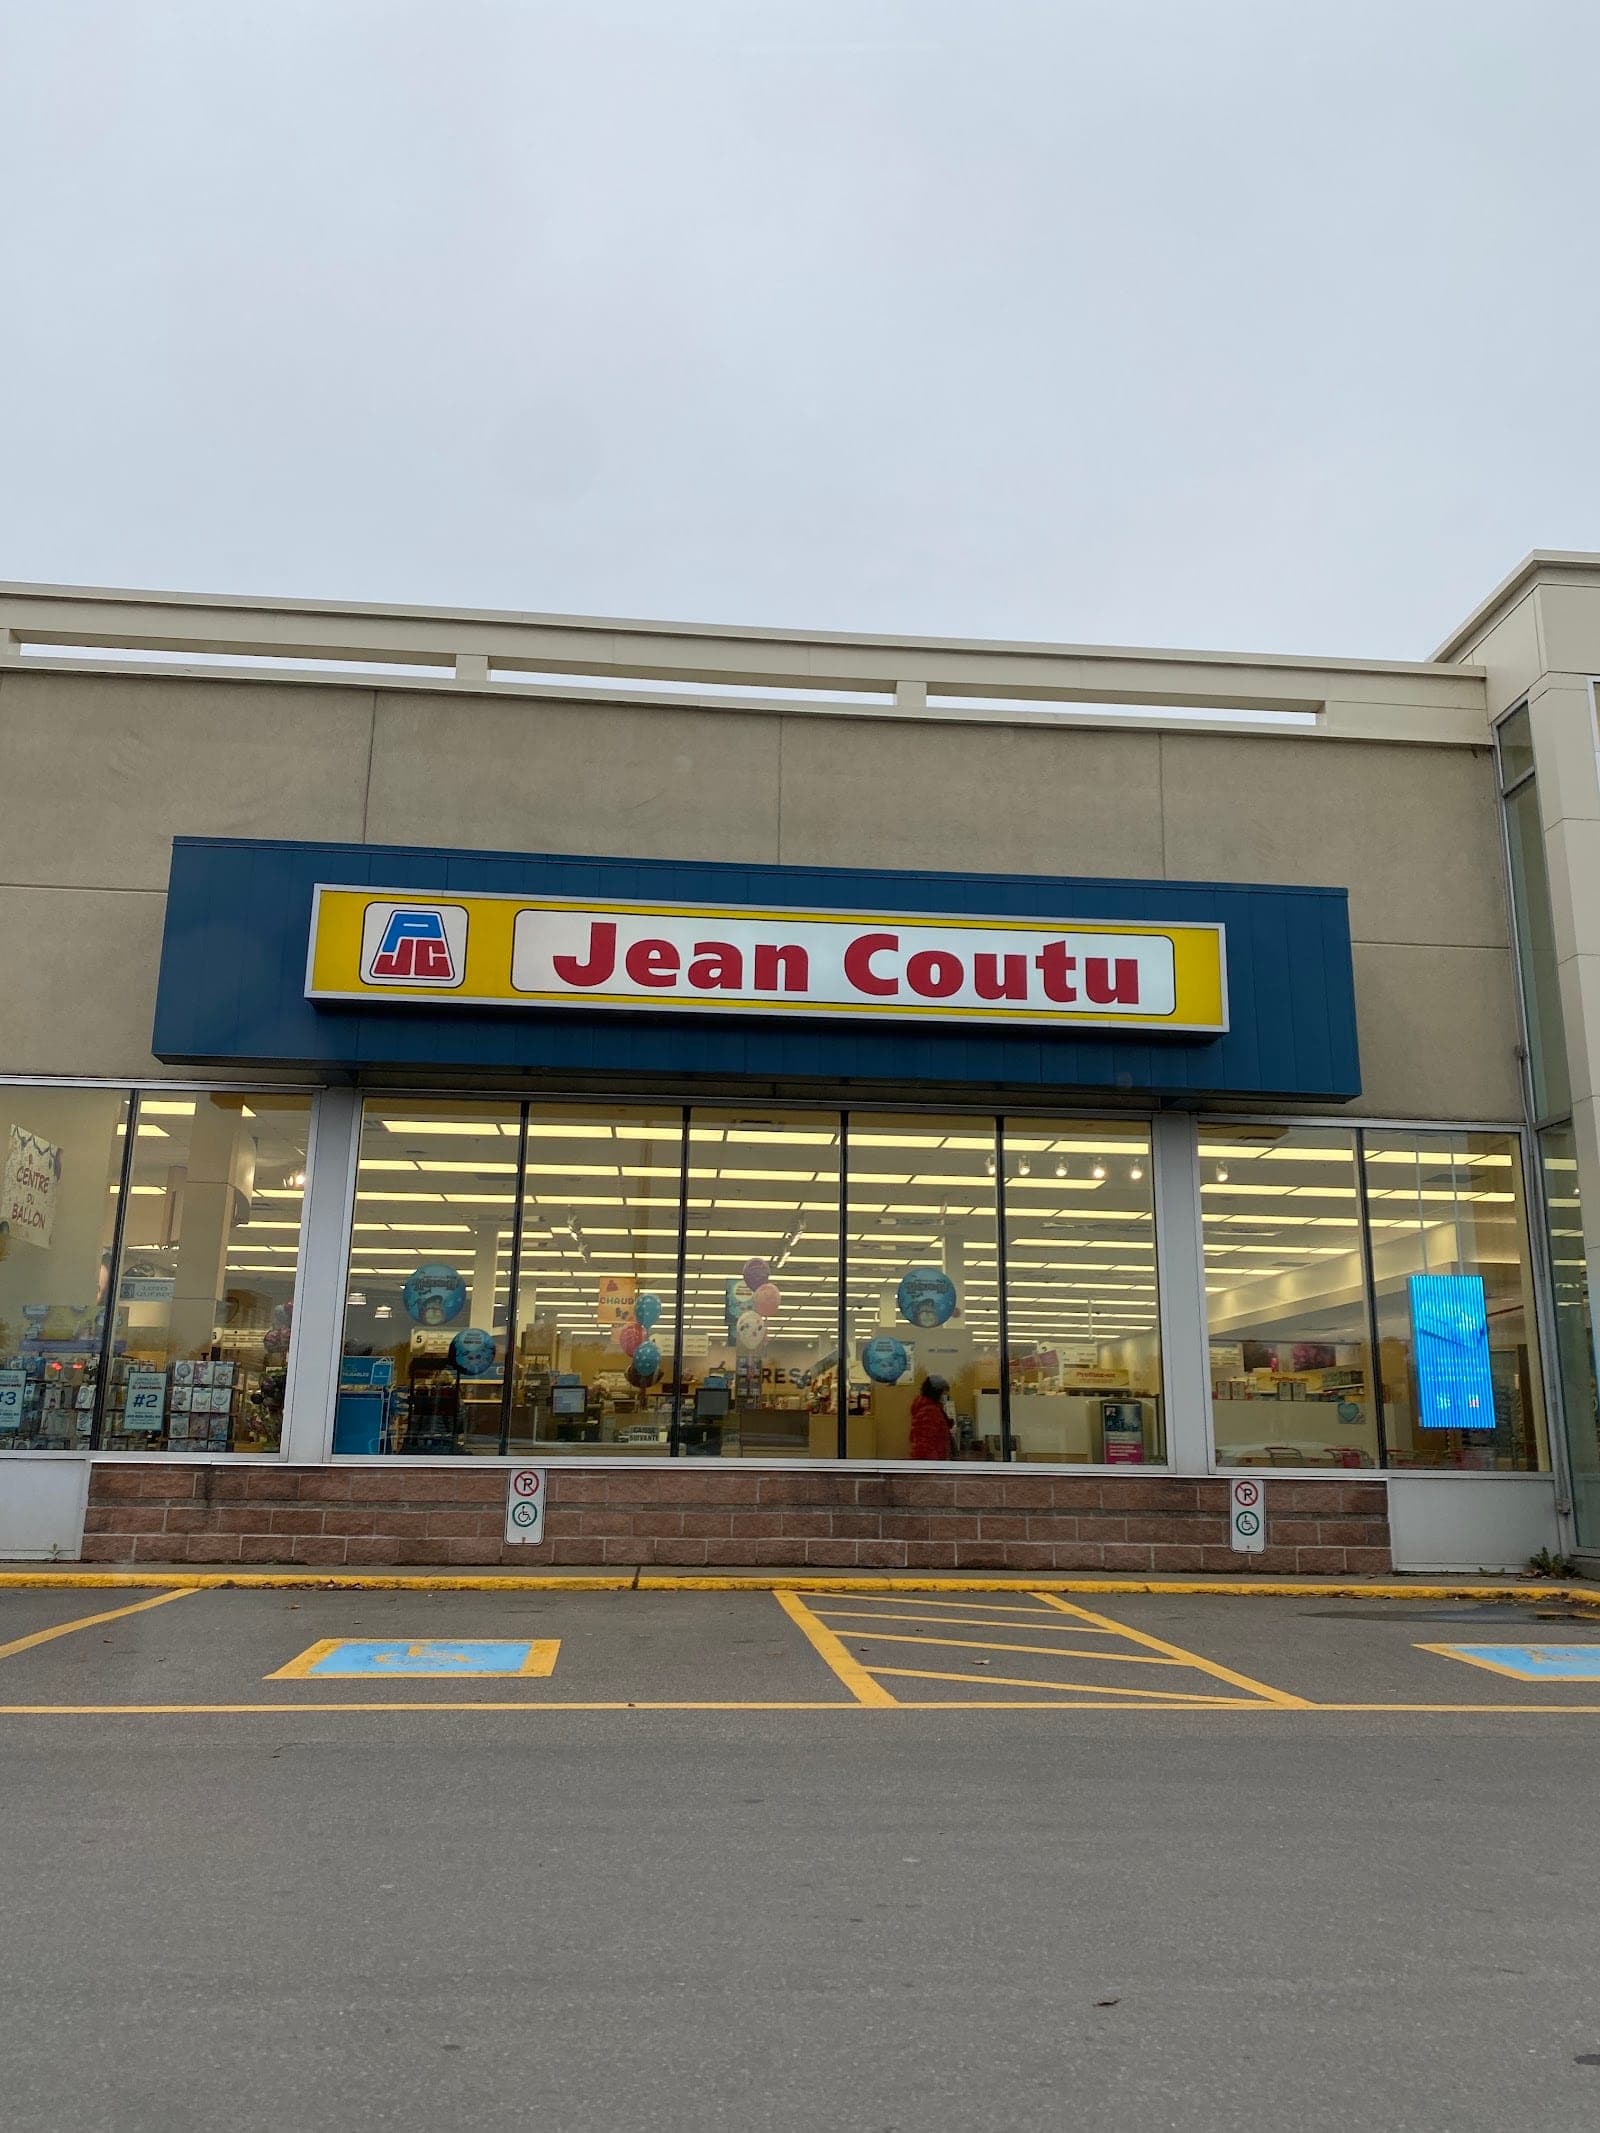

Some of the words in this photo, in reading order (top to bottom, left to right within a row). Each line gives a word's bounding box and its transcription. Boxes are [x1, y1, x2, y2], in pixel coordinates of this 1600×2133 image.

[552, 921, 809, 992] Jean
[844, 933, 1139, 1005] Coutu
[16, 1165, 50, 1194] CENTRE
[11, 1203, 46, 1230] BALLON
[415, 1335, 422, 1344] 5
[133, 1394, 158, 1408] #2
